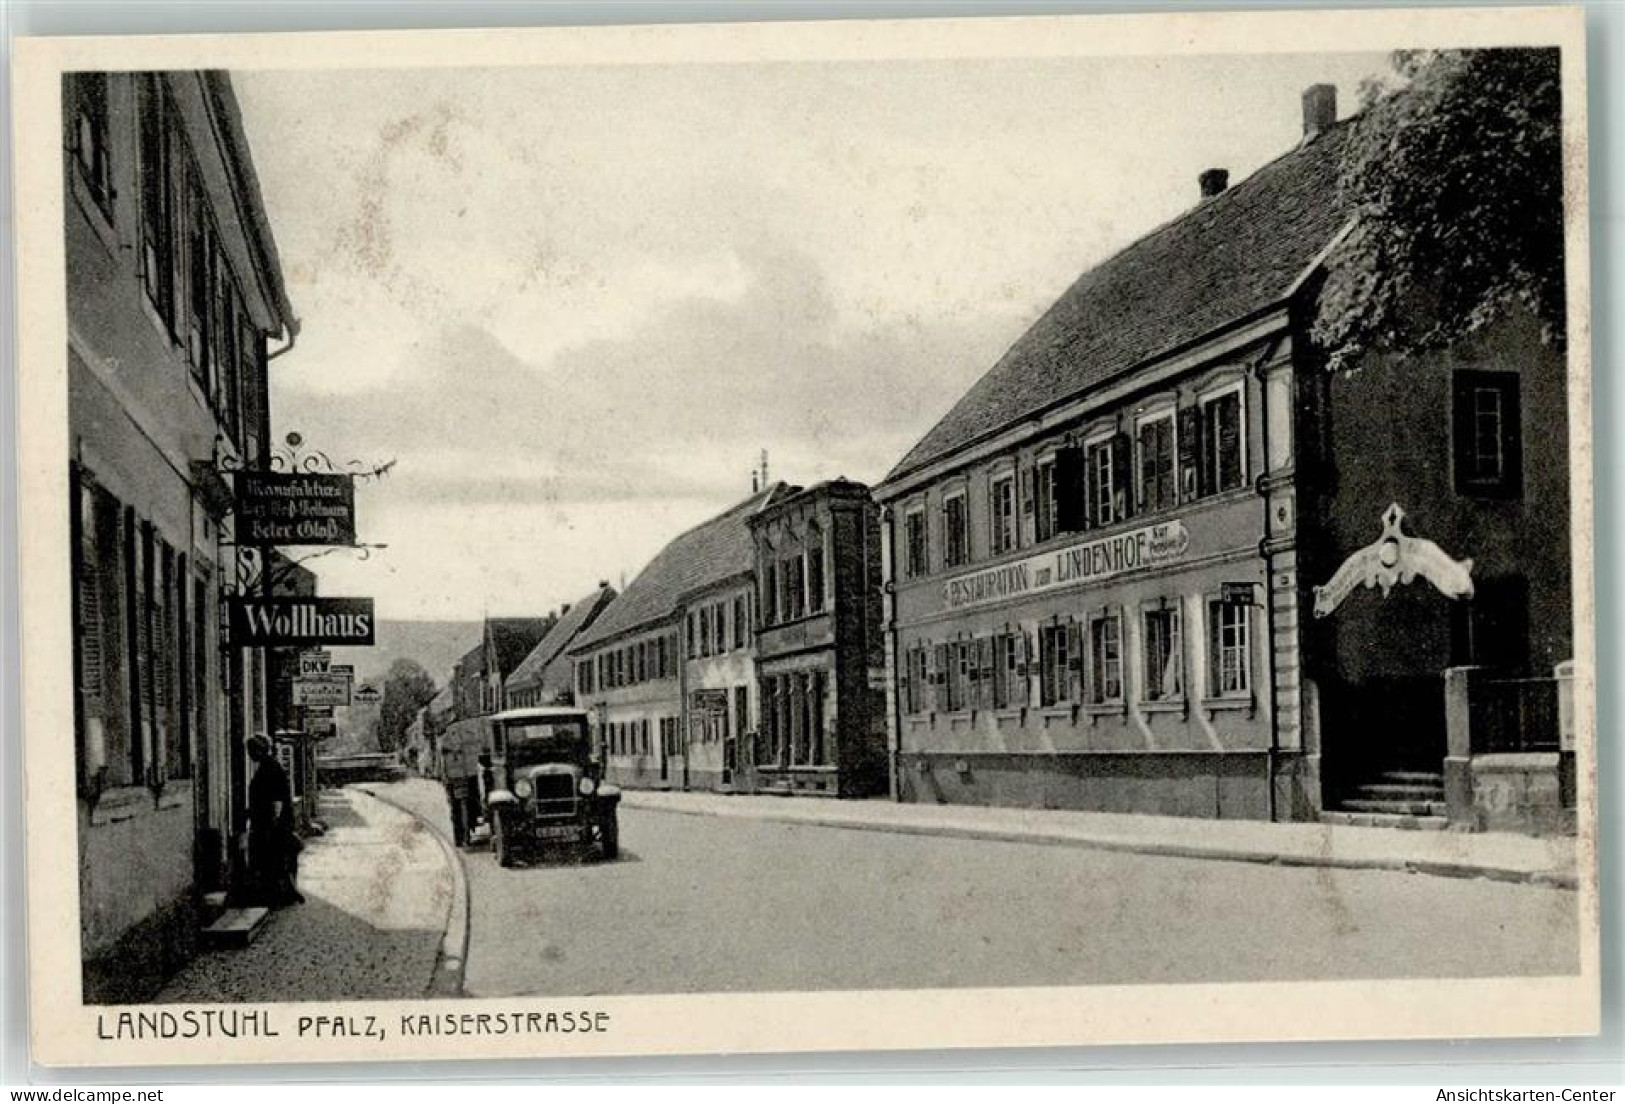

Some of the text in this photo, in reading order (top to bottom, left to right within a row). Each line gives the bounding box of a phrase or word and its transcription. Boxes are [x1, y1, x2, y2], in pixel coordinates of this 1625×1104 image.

[1056, 531, 1146, 582] LINDENHOF
[243, 604, 369, 637] Wollhaus
[303, 660, 330, 673] DKW
